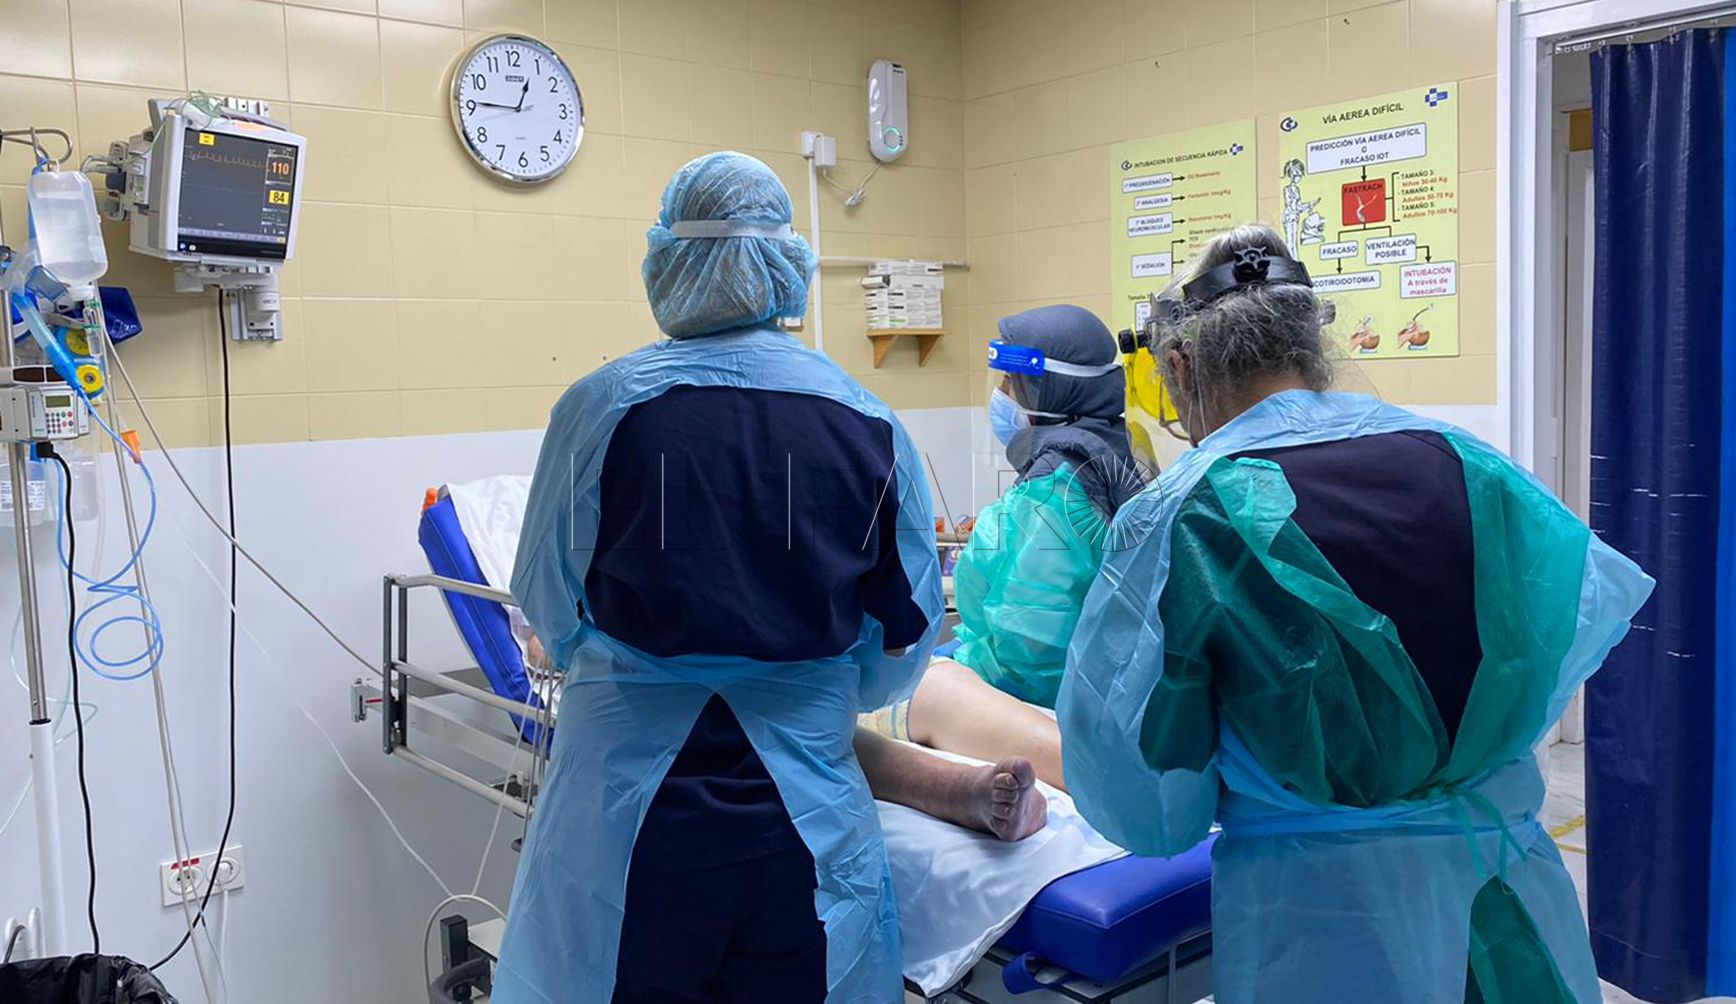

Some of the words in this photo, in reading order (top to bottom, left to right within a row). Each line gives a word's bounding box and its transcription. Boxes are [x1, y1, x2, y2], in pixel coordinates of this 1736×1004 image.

[486, 56, 499, 73] 11
[505, 50, 521, 67] 12
[534, 58, 540, 75] 1
[471, 73, 486, 91] 10
[548, 76, 558, 93] 2
[466, 99, 477, 116] 9
[558, 103, 568, 120] 3
[1322, 114, 1337, 124] VÍA
[1339, 109, 1370, 121] AEREA
[1372, 103, 1404, 116] DIFÍCIL
[477, 126, 487, 143] 8
[553, 129, 562, 145] 4
[1310, 140, 1353, 152] PREDICCIÓN
[1355, 136, 1367, 145] VÍA
[1368, 132, 1393, 143] AEREA
[1395, 128, 1421, 138] DIFÍCIL
[496, 144, 506, 161] 7
[518, 151, 528, 168] 6
[540, 145, 550, 162] 5
[1340, 154, 1375, 166] FRACASO
[271, 162, 289, 175] 110
[1401, 170, 1428, 179] TAMAÑO
[1344, 183, 1383, 194] FASTRACH
[1401, 186, 1428, 195] TAMAÑO
[273, 192, 285, 203] 84
[1401, 202, 1429, 211] TAMAÑO
[1322, 245, 1357, 256] FRACASO
[1366, 238, 1415, 251] VENTILACIÓN
[1375, 249, 1407, 259] POSIBLE
[1404, 265, 1451, 278] INTUBACIÓN
[1312, 276, 1375, 288] COTIROIDOTOMIA
[1407, 279, 1414, 287] A
[1415, 277, 1437, 286] través
[1439, 276, 1448, 284] de
[1409, 287, 1447, 296] mascarilla
